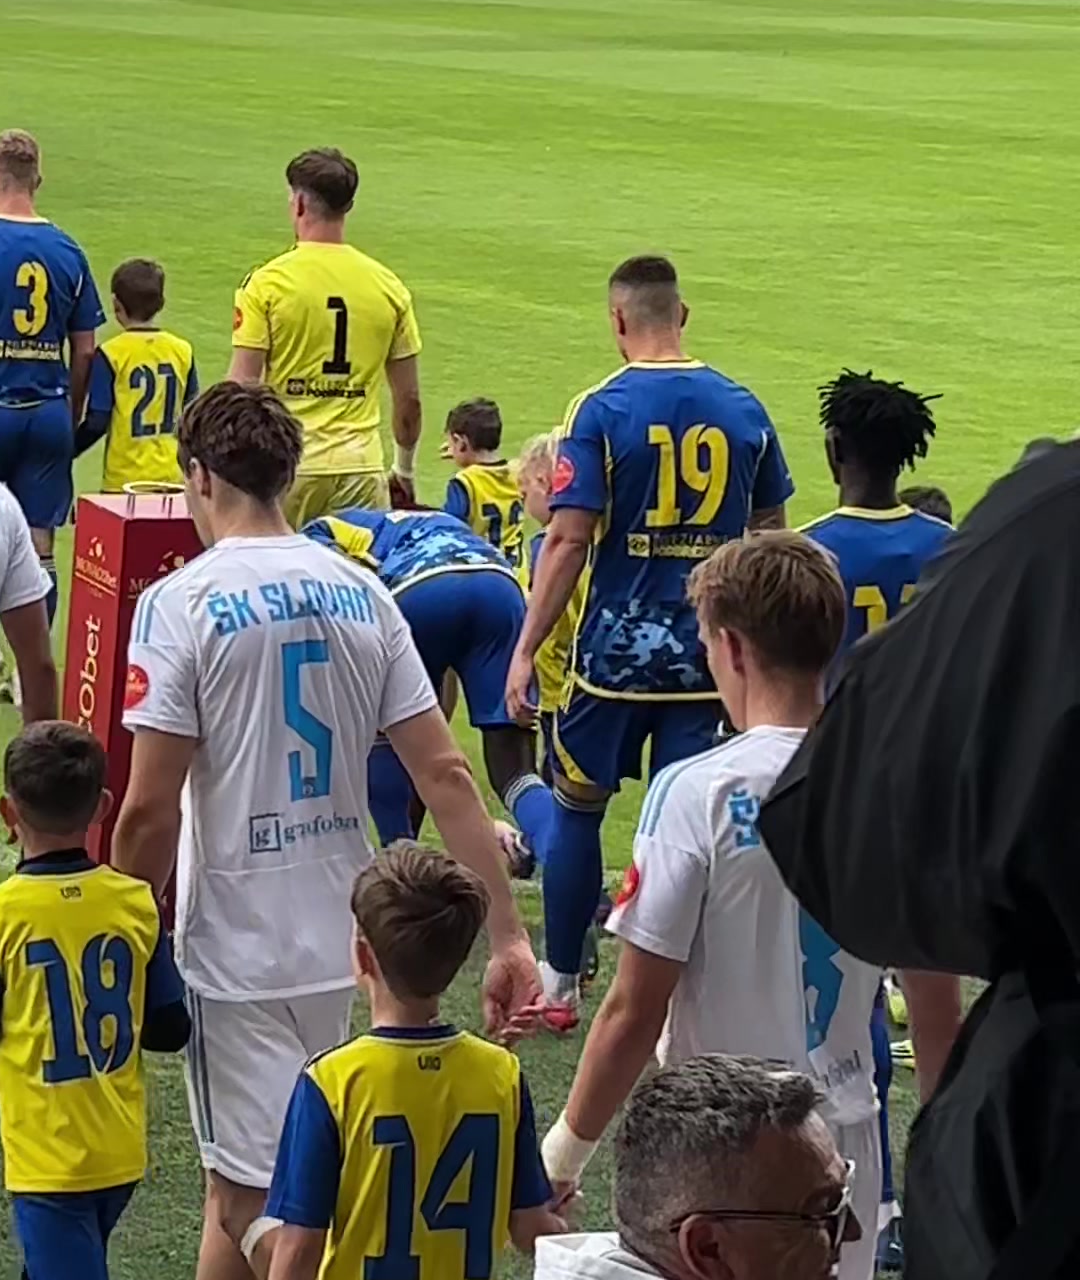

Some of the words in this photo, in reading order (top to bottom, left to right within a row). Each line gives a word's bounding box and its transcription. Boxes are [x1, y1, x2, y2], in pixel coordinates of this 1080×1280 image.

[13, 261, 49, 337] 3
[322, 297, 351, 374] 1
[129, 363, 177, 438] 21
[645, 424, 728, 527] 19
[207, 589, 261, 637] ŠK
[281, 638, 333, 803] 5
[25, 932, 134, 1084] 18
